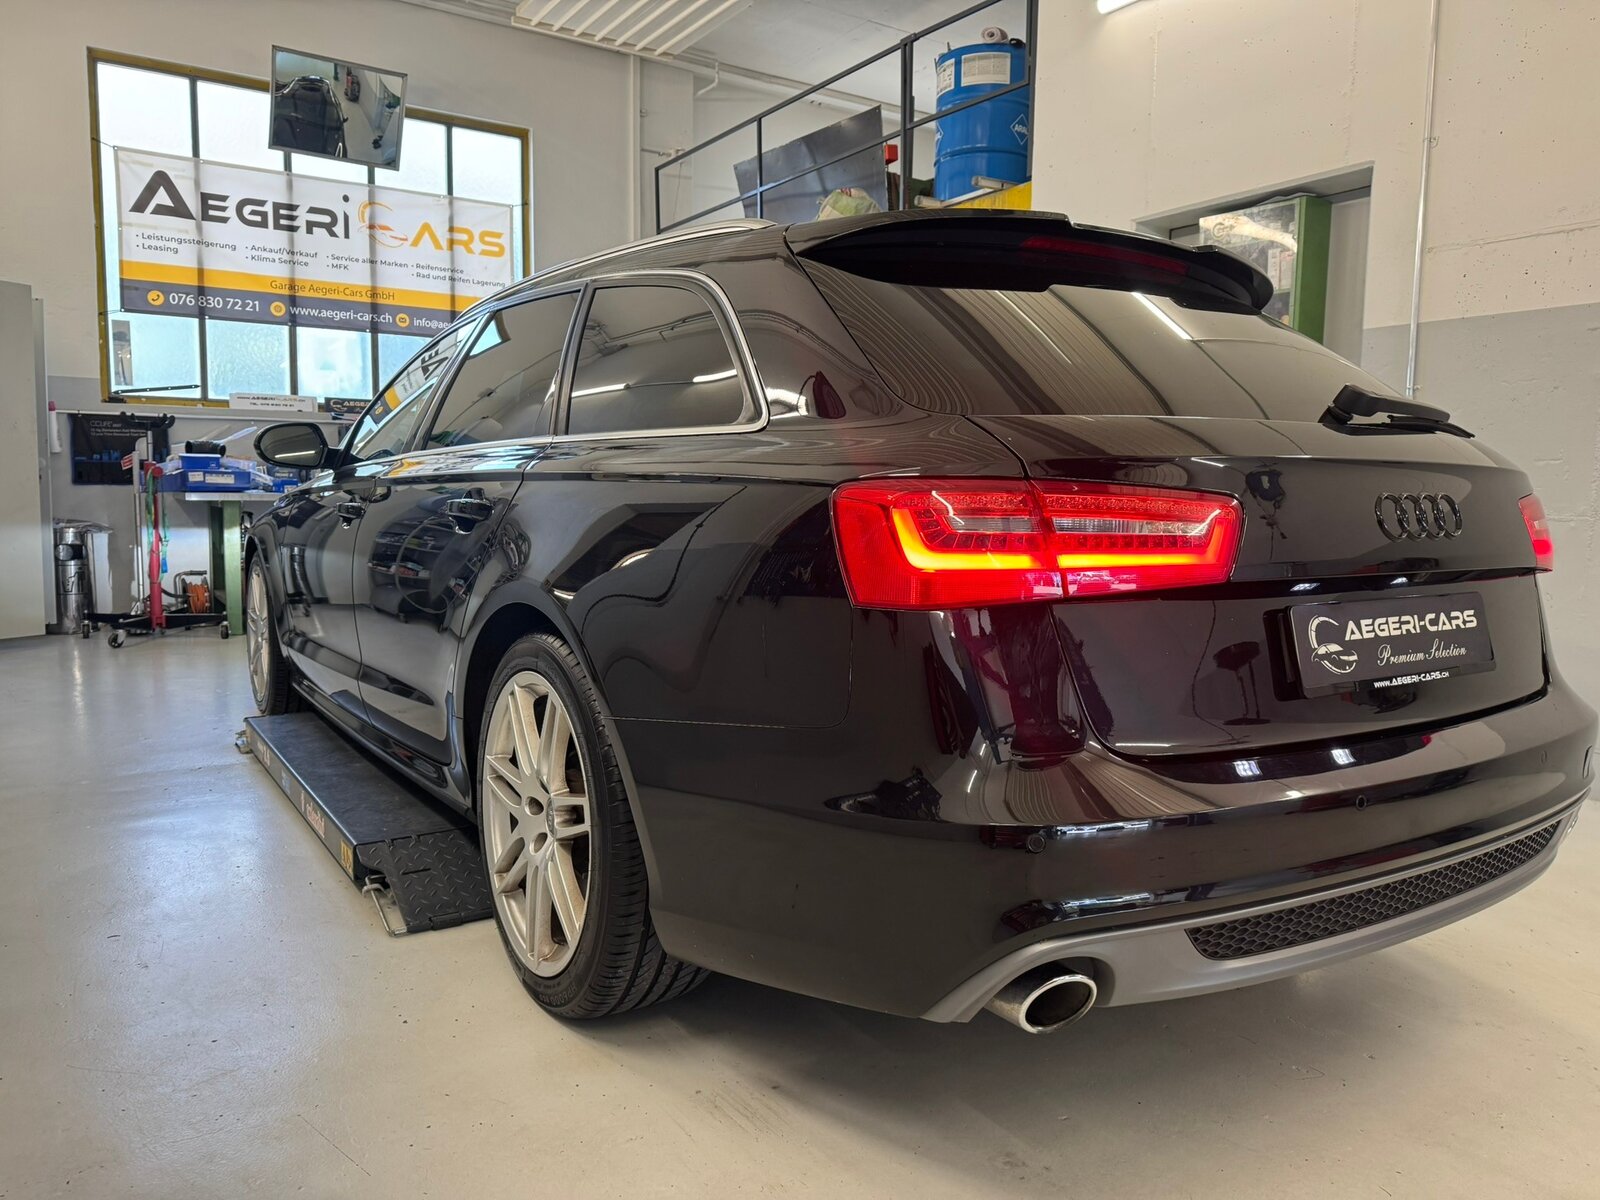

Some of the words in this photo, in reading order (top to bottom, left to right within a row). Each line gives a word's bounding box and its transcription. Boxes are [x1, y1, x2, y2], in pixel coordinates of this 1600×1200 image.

[141, 232, 237, 251] Leistungssteigerung
[142, 242, 179, 254] Leasing
[250, 244, 318, 259] Ankauf/Verkauf
[250, 254, 276, 264] Klima
[278, 257, 309, 267] Service
[330, 253, 360, 263] Service
[361, 257, 378, 265] aller
[380, 259, 409, 269] Marken
[331, 262, 350, 271] MFK
[415, 262, 464, 275] Reifenservice
[415, 271, 431, 280] Rad
[432, 273, 447, 281] und
[448, 274, 471, 285] Reifen
[472, 278, 506, 289] Lagerung
[270, 280, 306, 293] Garage
[308, 283, 363, 298] Aegeri-Cars
[365, 287, 395, 301] GmbH
[169, 292, 196, 307] 076
[198, 295, 223, 309] 830
[226, 298, 243, 311] 72
[246, 299, 260, 312] 21
[289, 305, 393, 324] www.aegeri-cars.ch
[1344, 609, 1478, 641] AEGERI-CARS
[1377, 643, 1425, 667] Premium
[1425, 638, 1467, 661] Selection
